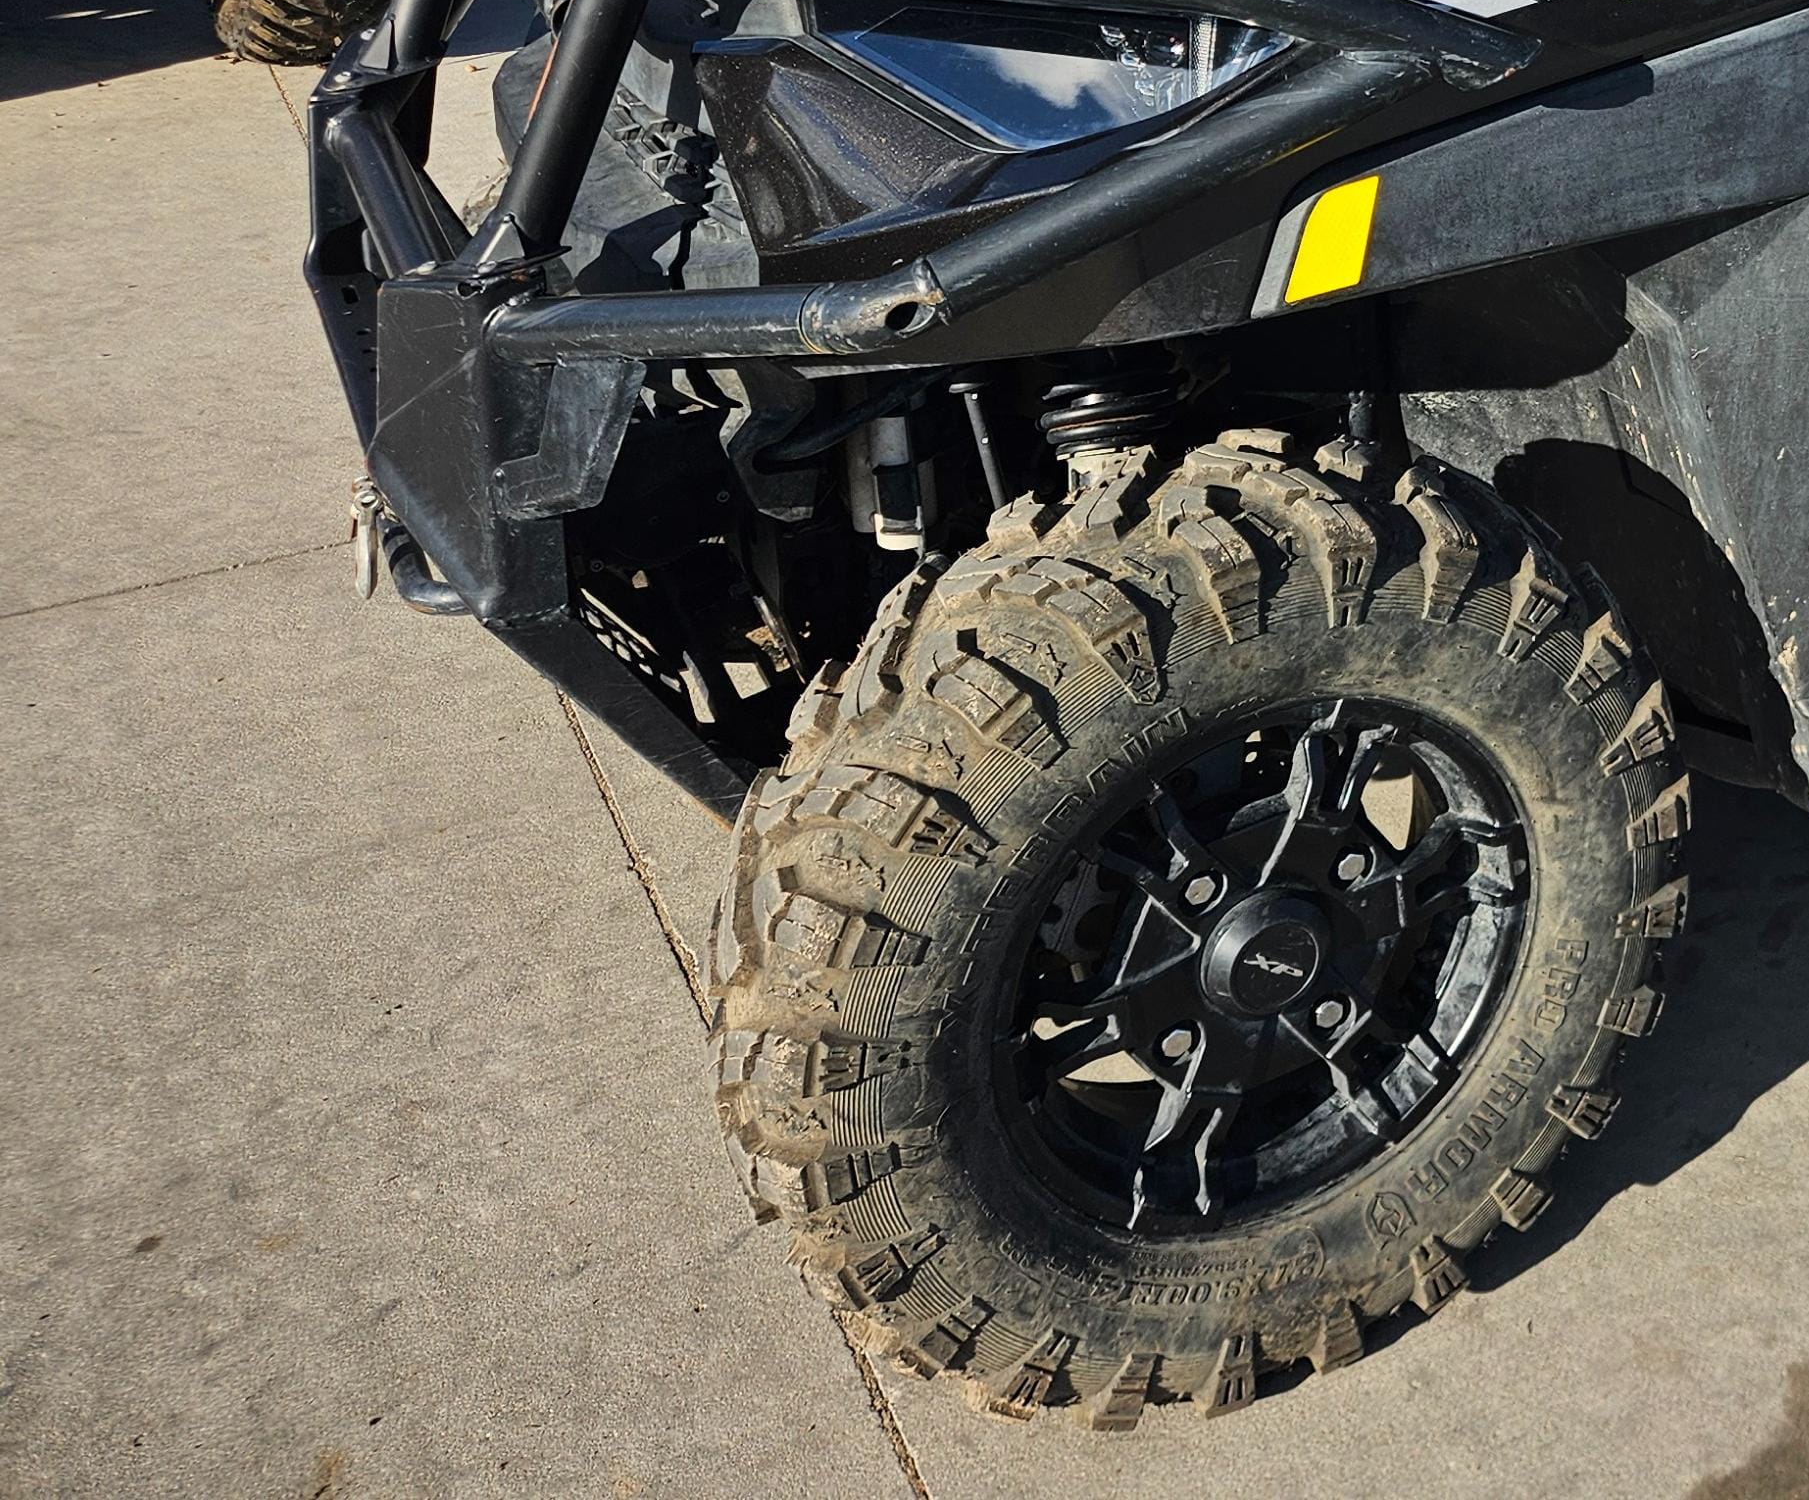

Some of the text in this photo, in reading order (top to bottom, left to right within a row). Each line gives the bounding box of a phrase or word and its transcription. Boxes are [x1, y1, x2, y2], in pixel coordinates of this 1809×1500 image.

[1243, 952, 1304, 978] XP
[1405, 938, 1590, 1199] PRO ARMOR
